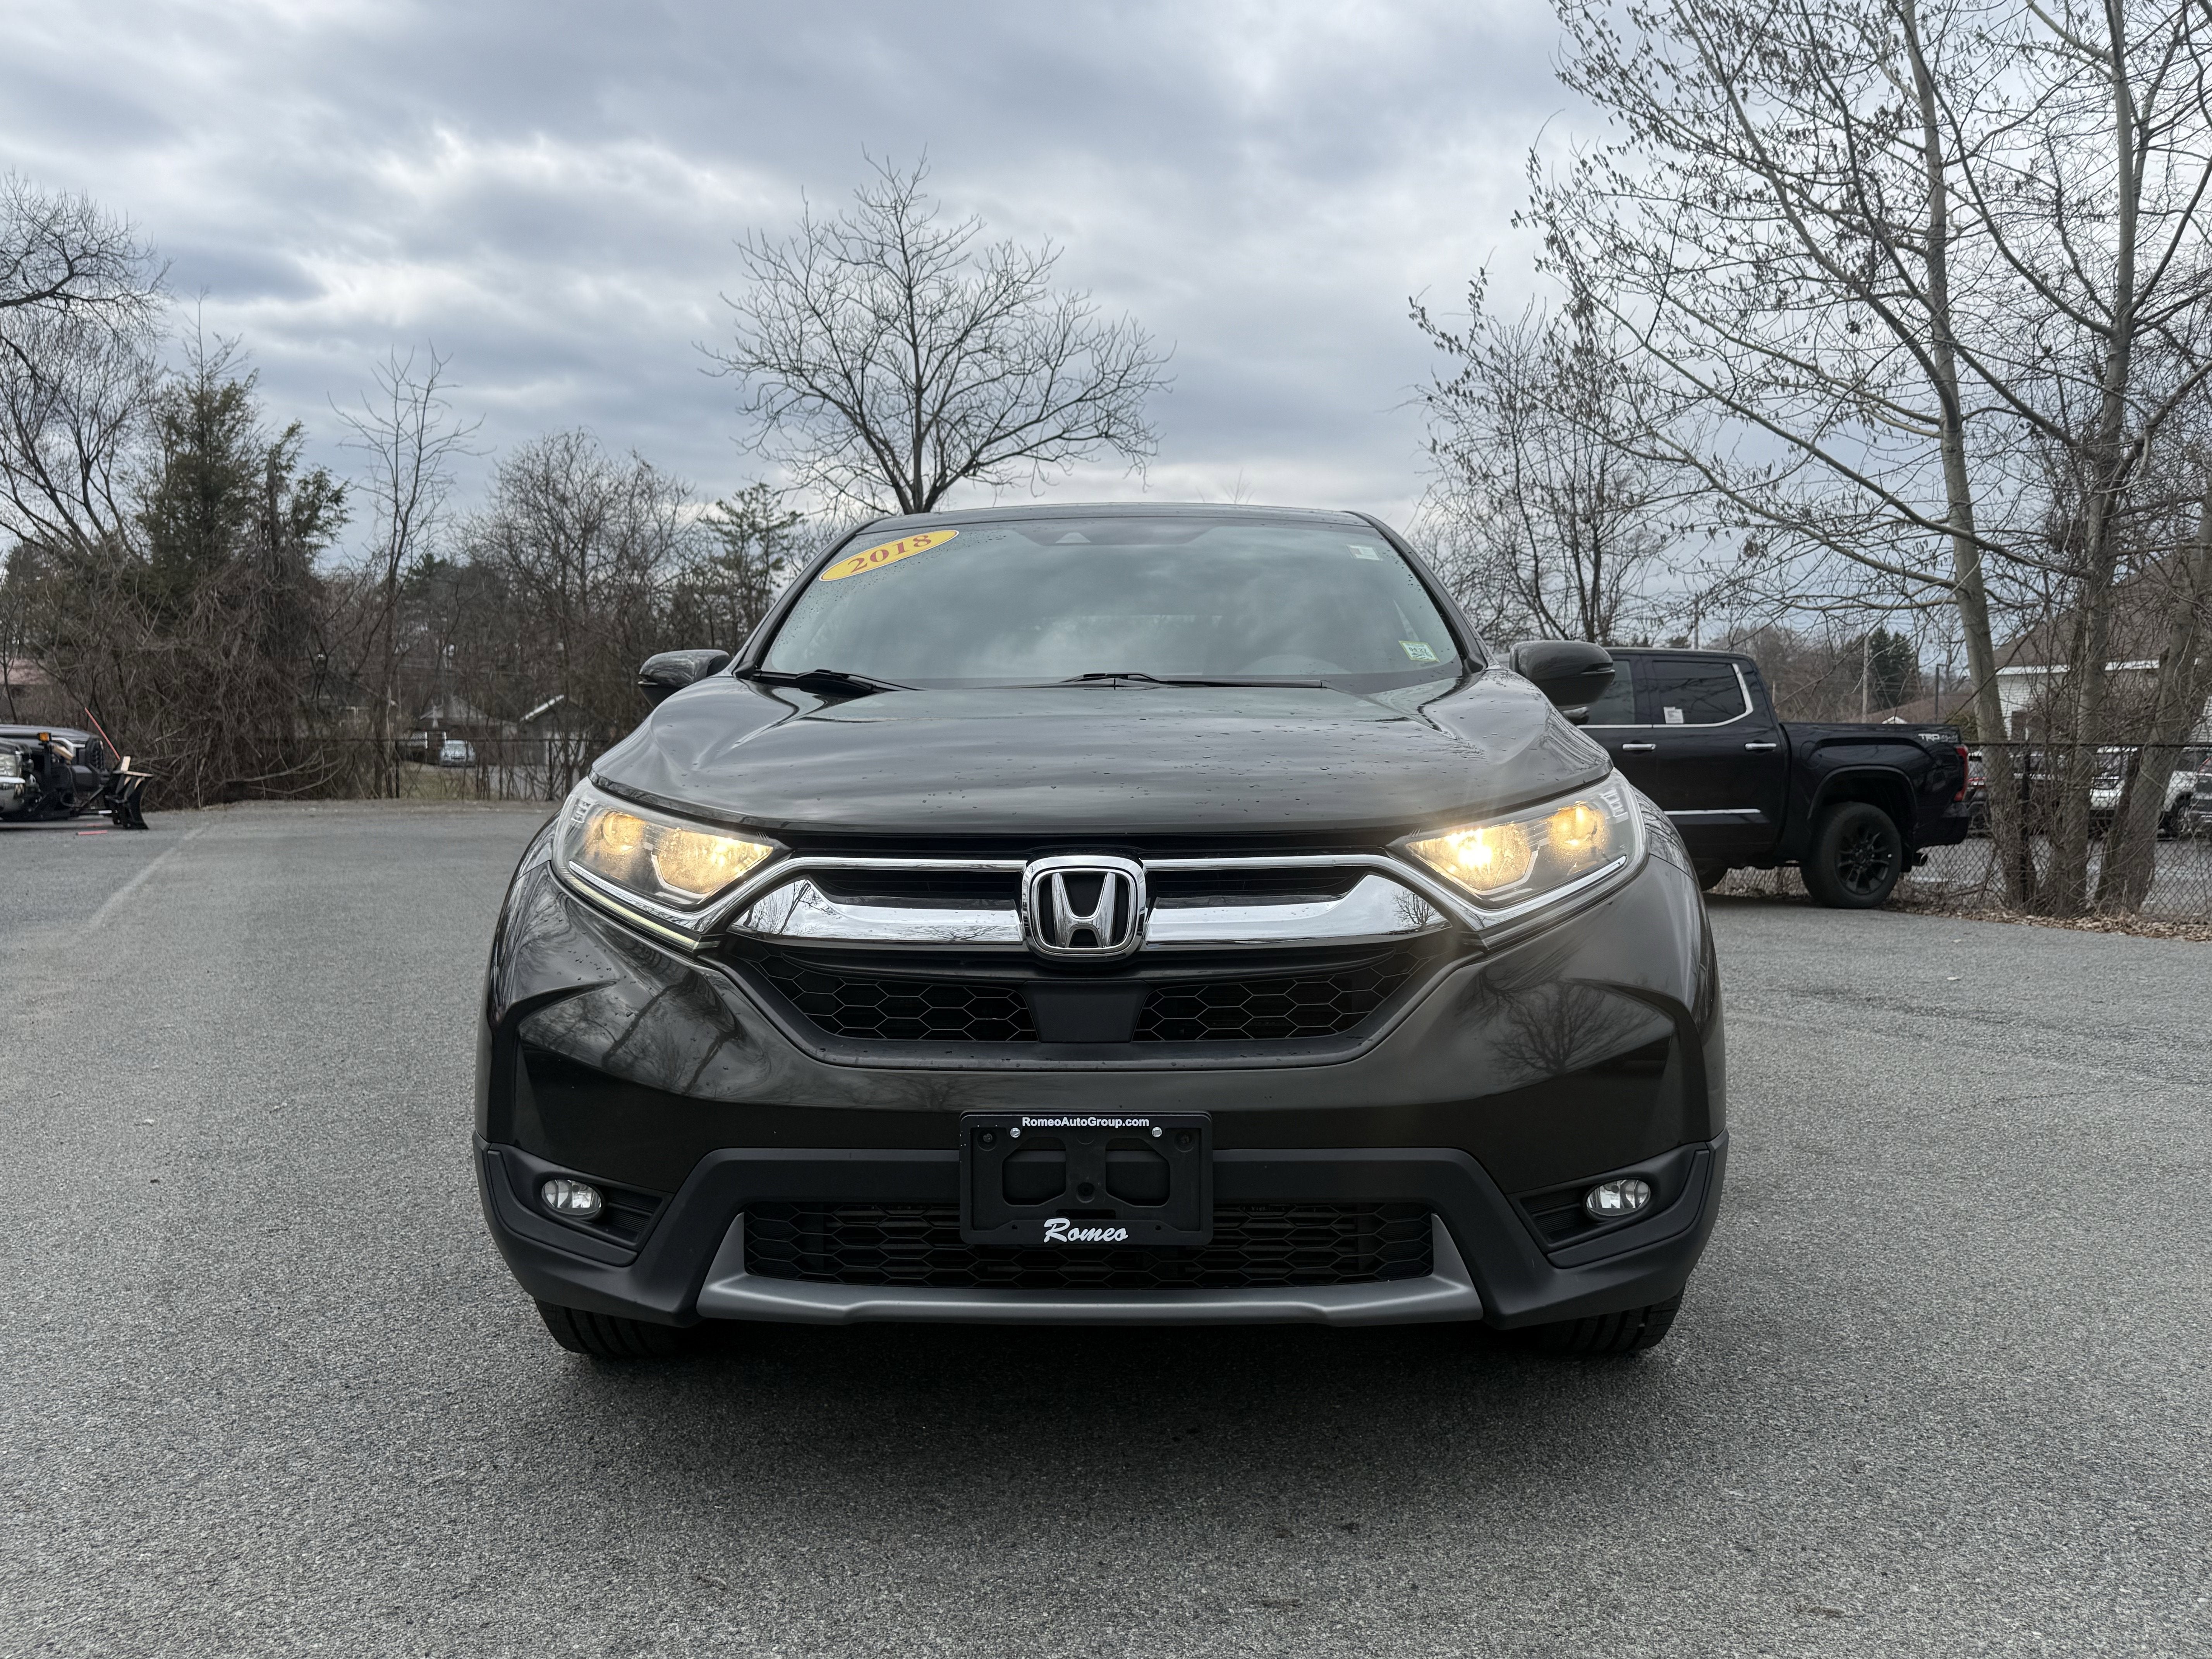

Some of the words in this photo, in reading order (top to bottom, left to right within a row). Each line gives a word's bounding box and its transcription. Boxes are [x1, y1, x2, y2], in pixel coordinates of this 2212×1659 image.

[848, 535, 931, 573] 2018
[1918, 733, 1940, 742] TRD
[1022, 1117, 1149, 1128] RomeoAutoGroup.com
[1044, 1218, 1128, 1243] Romeo
